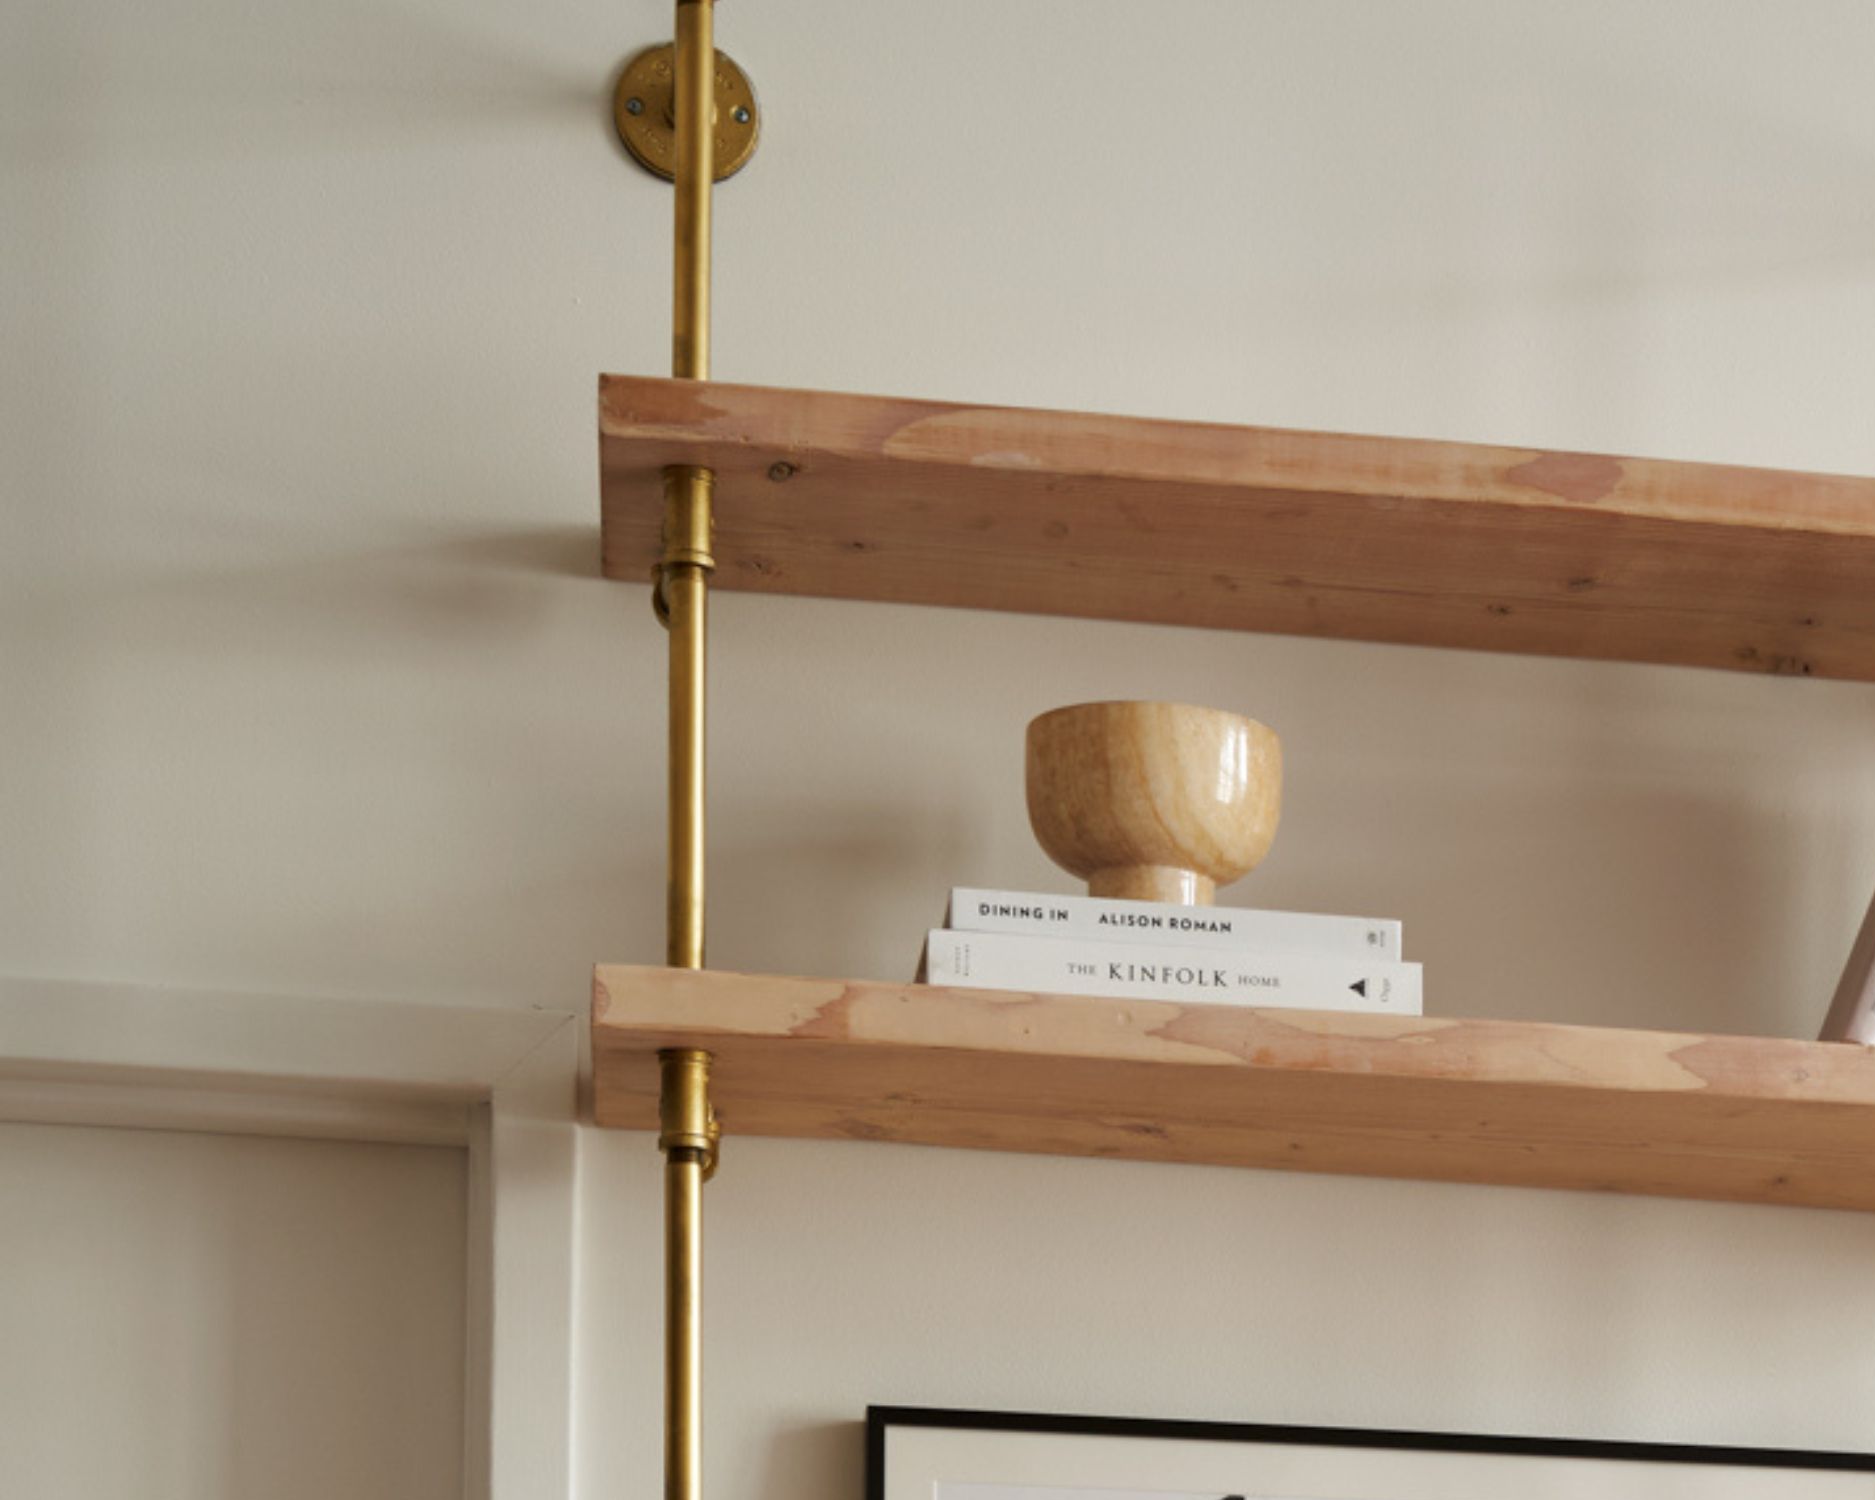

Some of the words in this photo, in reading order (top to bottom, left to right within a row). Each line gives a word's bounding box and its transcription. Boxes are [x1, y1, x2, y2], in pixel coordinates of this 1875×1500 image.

[978, 902, 1043, 920] DINING
[1049, 907, 1069, 921] IN
[1099, 912, 1163, 928] ALISON
[1169, 917, 1233, 933] ROMAN
[1067, 962, 1097, 976] THE
[1108, 962, 1229, 988] KINFOLK
[1238, 974, 1281, 988] HOME
